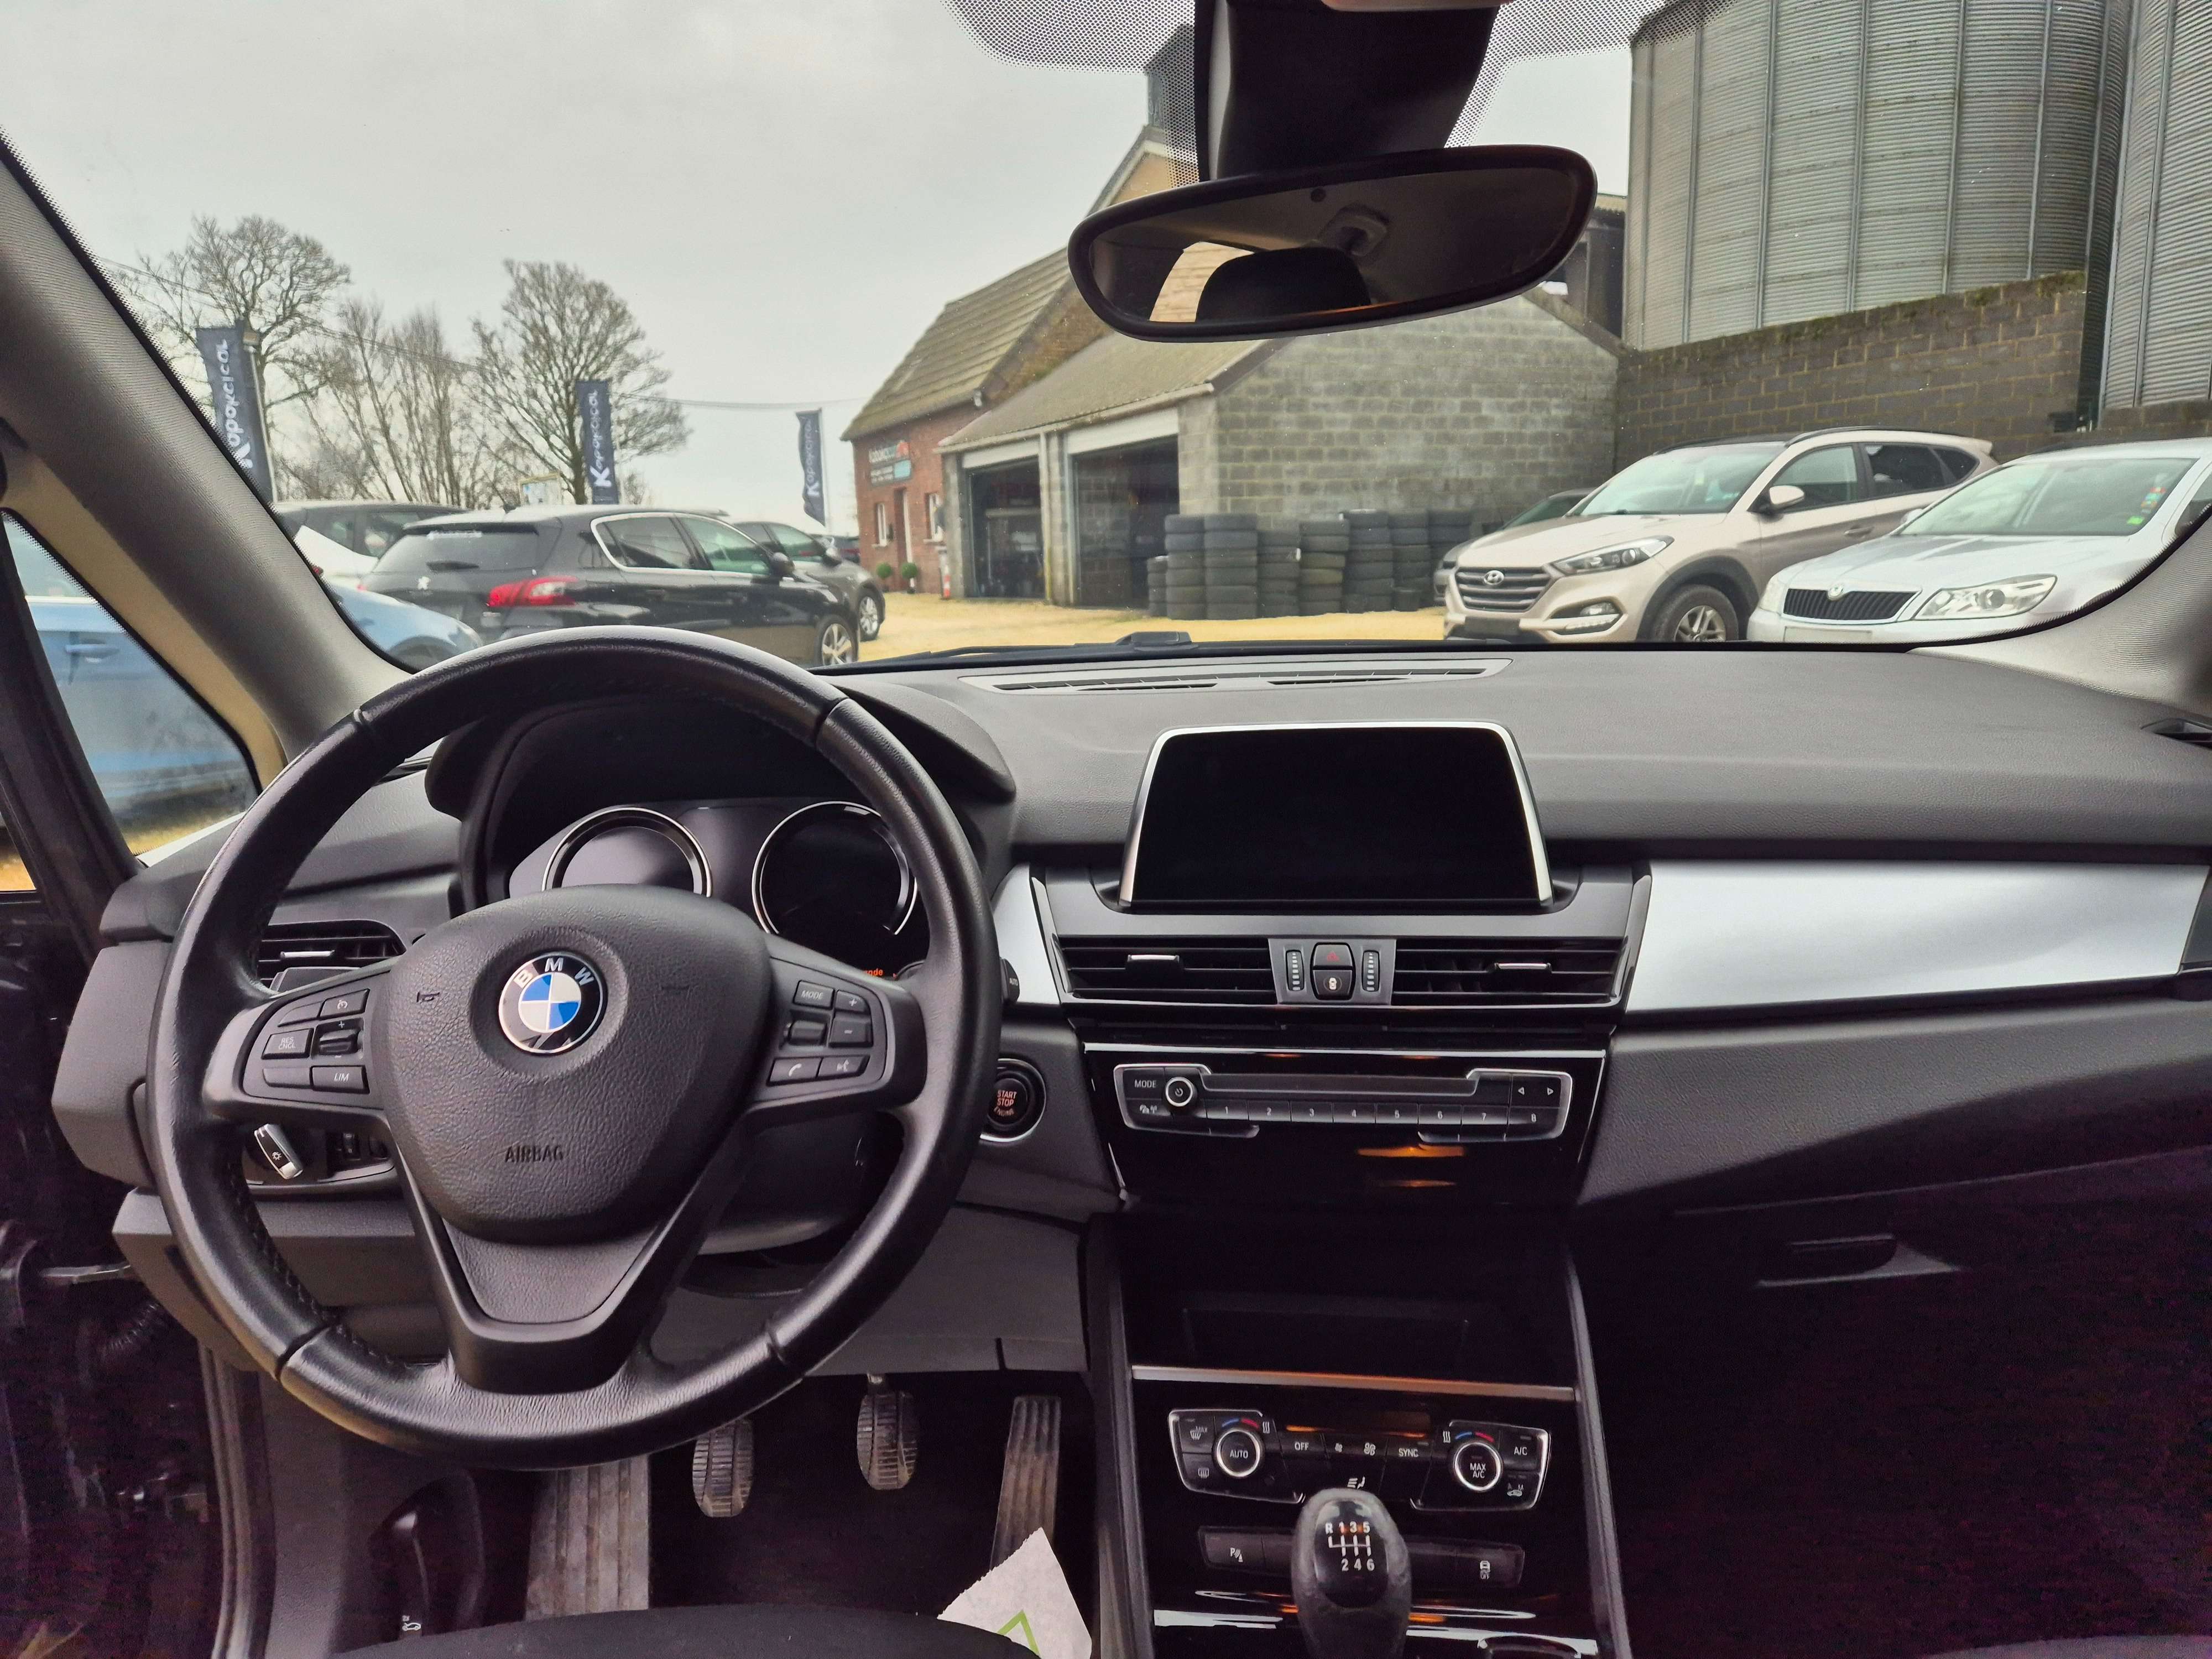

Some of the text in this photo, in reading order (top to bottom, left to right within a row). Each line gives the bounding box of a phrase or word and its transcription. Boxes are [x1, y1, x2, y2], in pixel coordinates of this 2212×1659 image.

[513, 957, 594, 988] BMW
[801, 990, 823, 1000] MODE
[333, 1073, 349, 1082] LIM
[1134, 1079, 1157, 1088] MODE
[997, 1089, 1018, 1099] START
[997, 1097, 1014, 1107] STOP
[1267, 1107, 1271, 1116] 2
[1310, 1108, 1314, 1118] 3
[1352, 1109, 1357, 1118] 4
[1395, 1110, 1400, 1119] 5
[1438, 1110, 1443, 1119] 6
[1482, 1112, 1486, 1121] 7
[1531, 1113, 1536, 1123] 8
[505, 1145, 564, 1162] AIRBAG
[1294, 1442, 1309, 1451] OFF
[1514, 1446, 1527, 1456] A/C
[1229, 1449, 1249, 1459] AUTO
[1398, 1447, 1419, 1458] SYNC
[1470, 1462, 1486, 1472] MAX
[1473, 1469, 1485, 1479] A/C
[1326, 1521, 1370, 1535] R 1 3 5
[1341, 1558, 1375, 1571] 2 4 6
